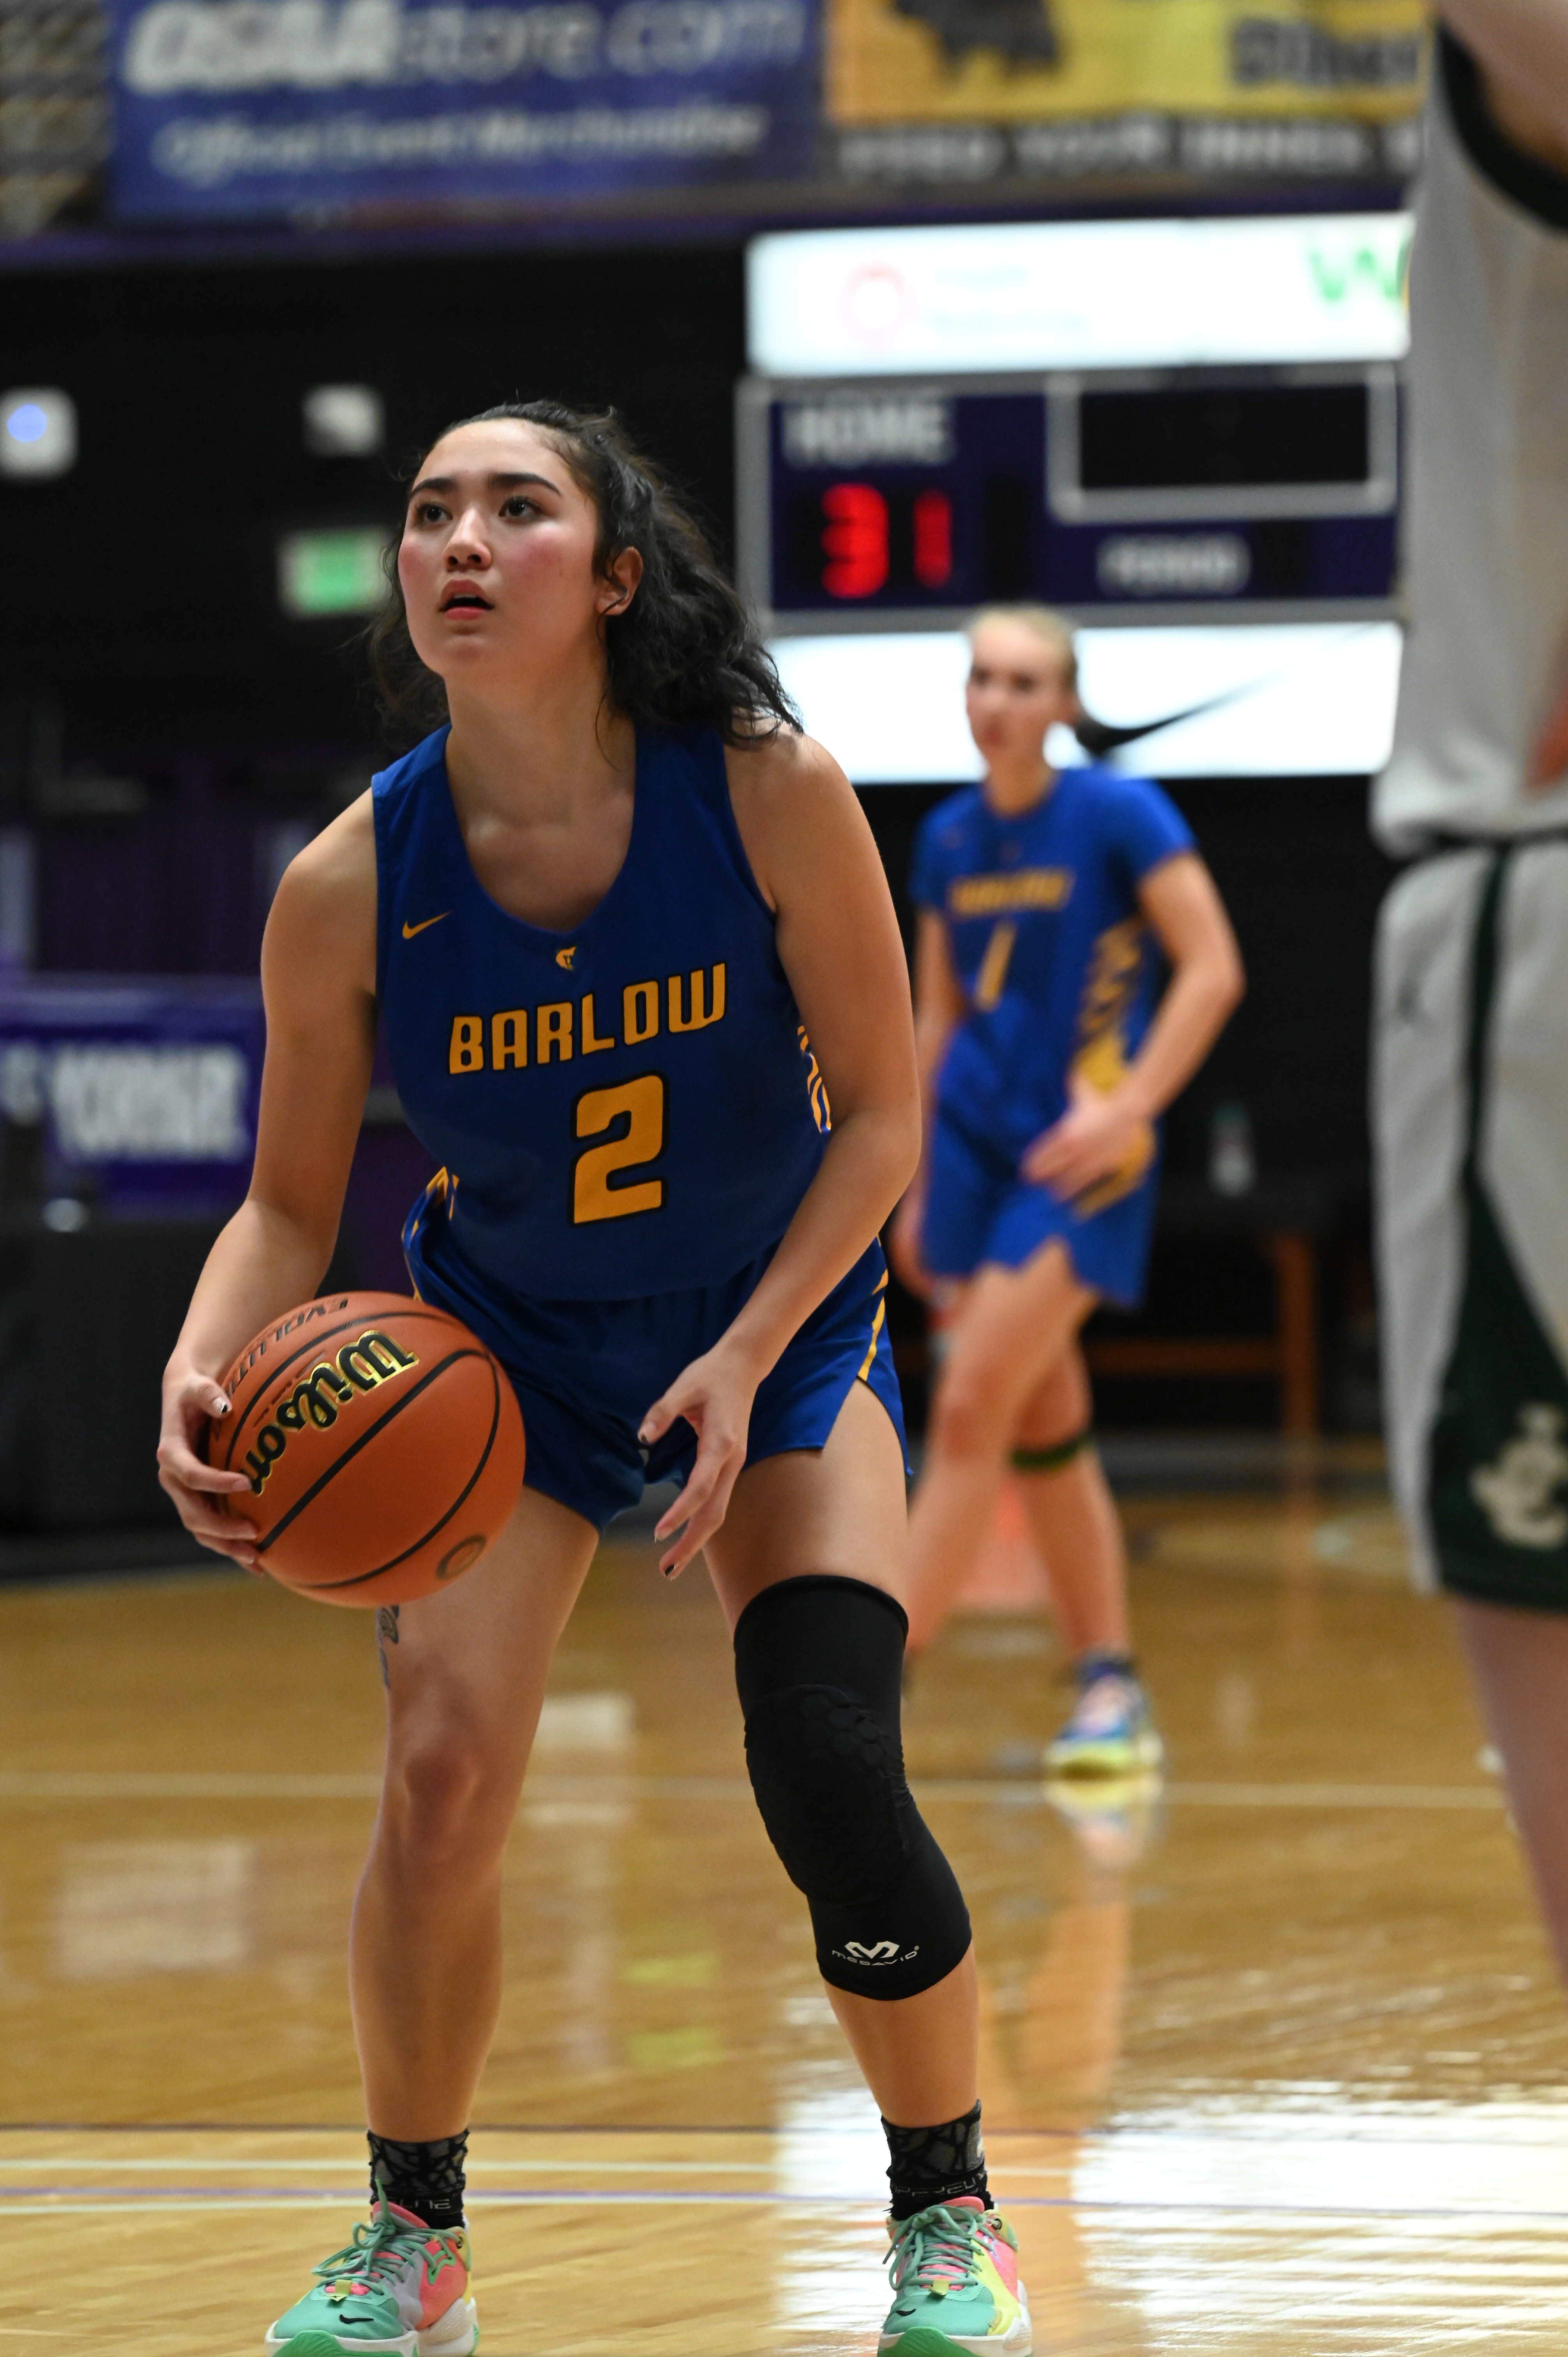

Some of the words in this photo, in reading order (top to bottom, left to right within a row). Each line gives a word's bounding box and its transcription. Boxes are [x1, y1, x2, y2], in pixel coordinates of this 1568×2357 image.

[447, 961, 727, 1076] BARLOW
[570, 1072, 665, 1226] 2
[241, 1330, 419, 1497] Wilson
